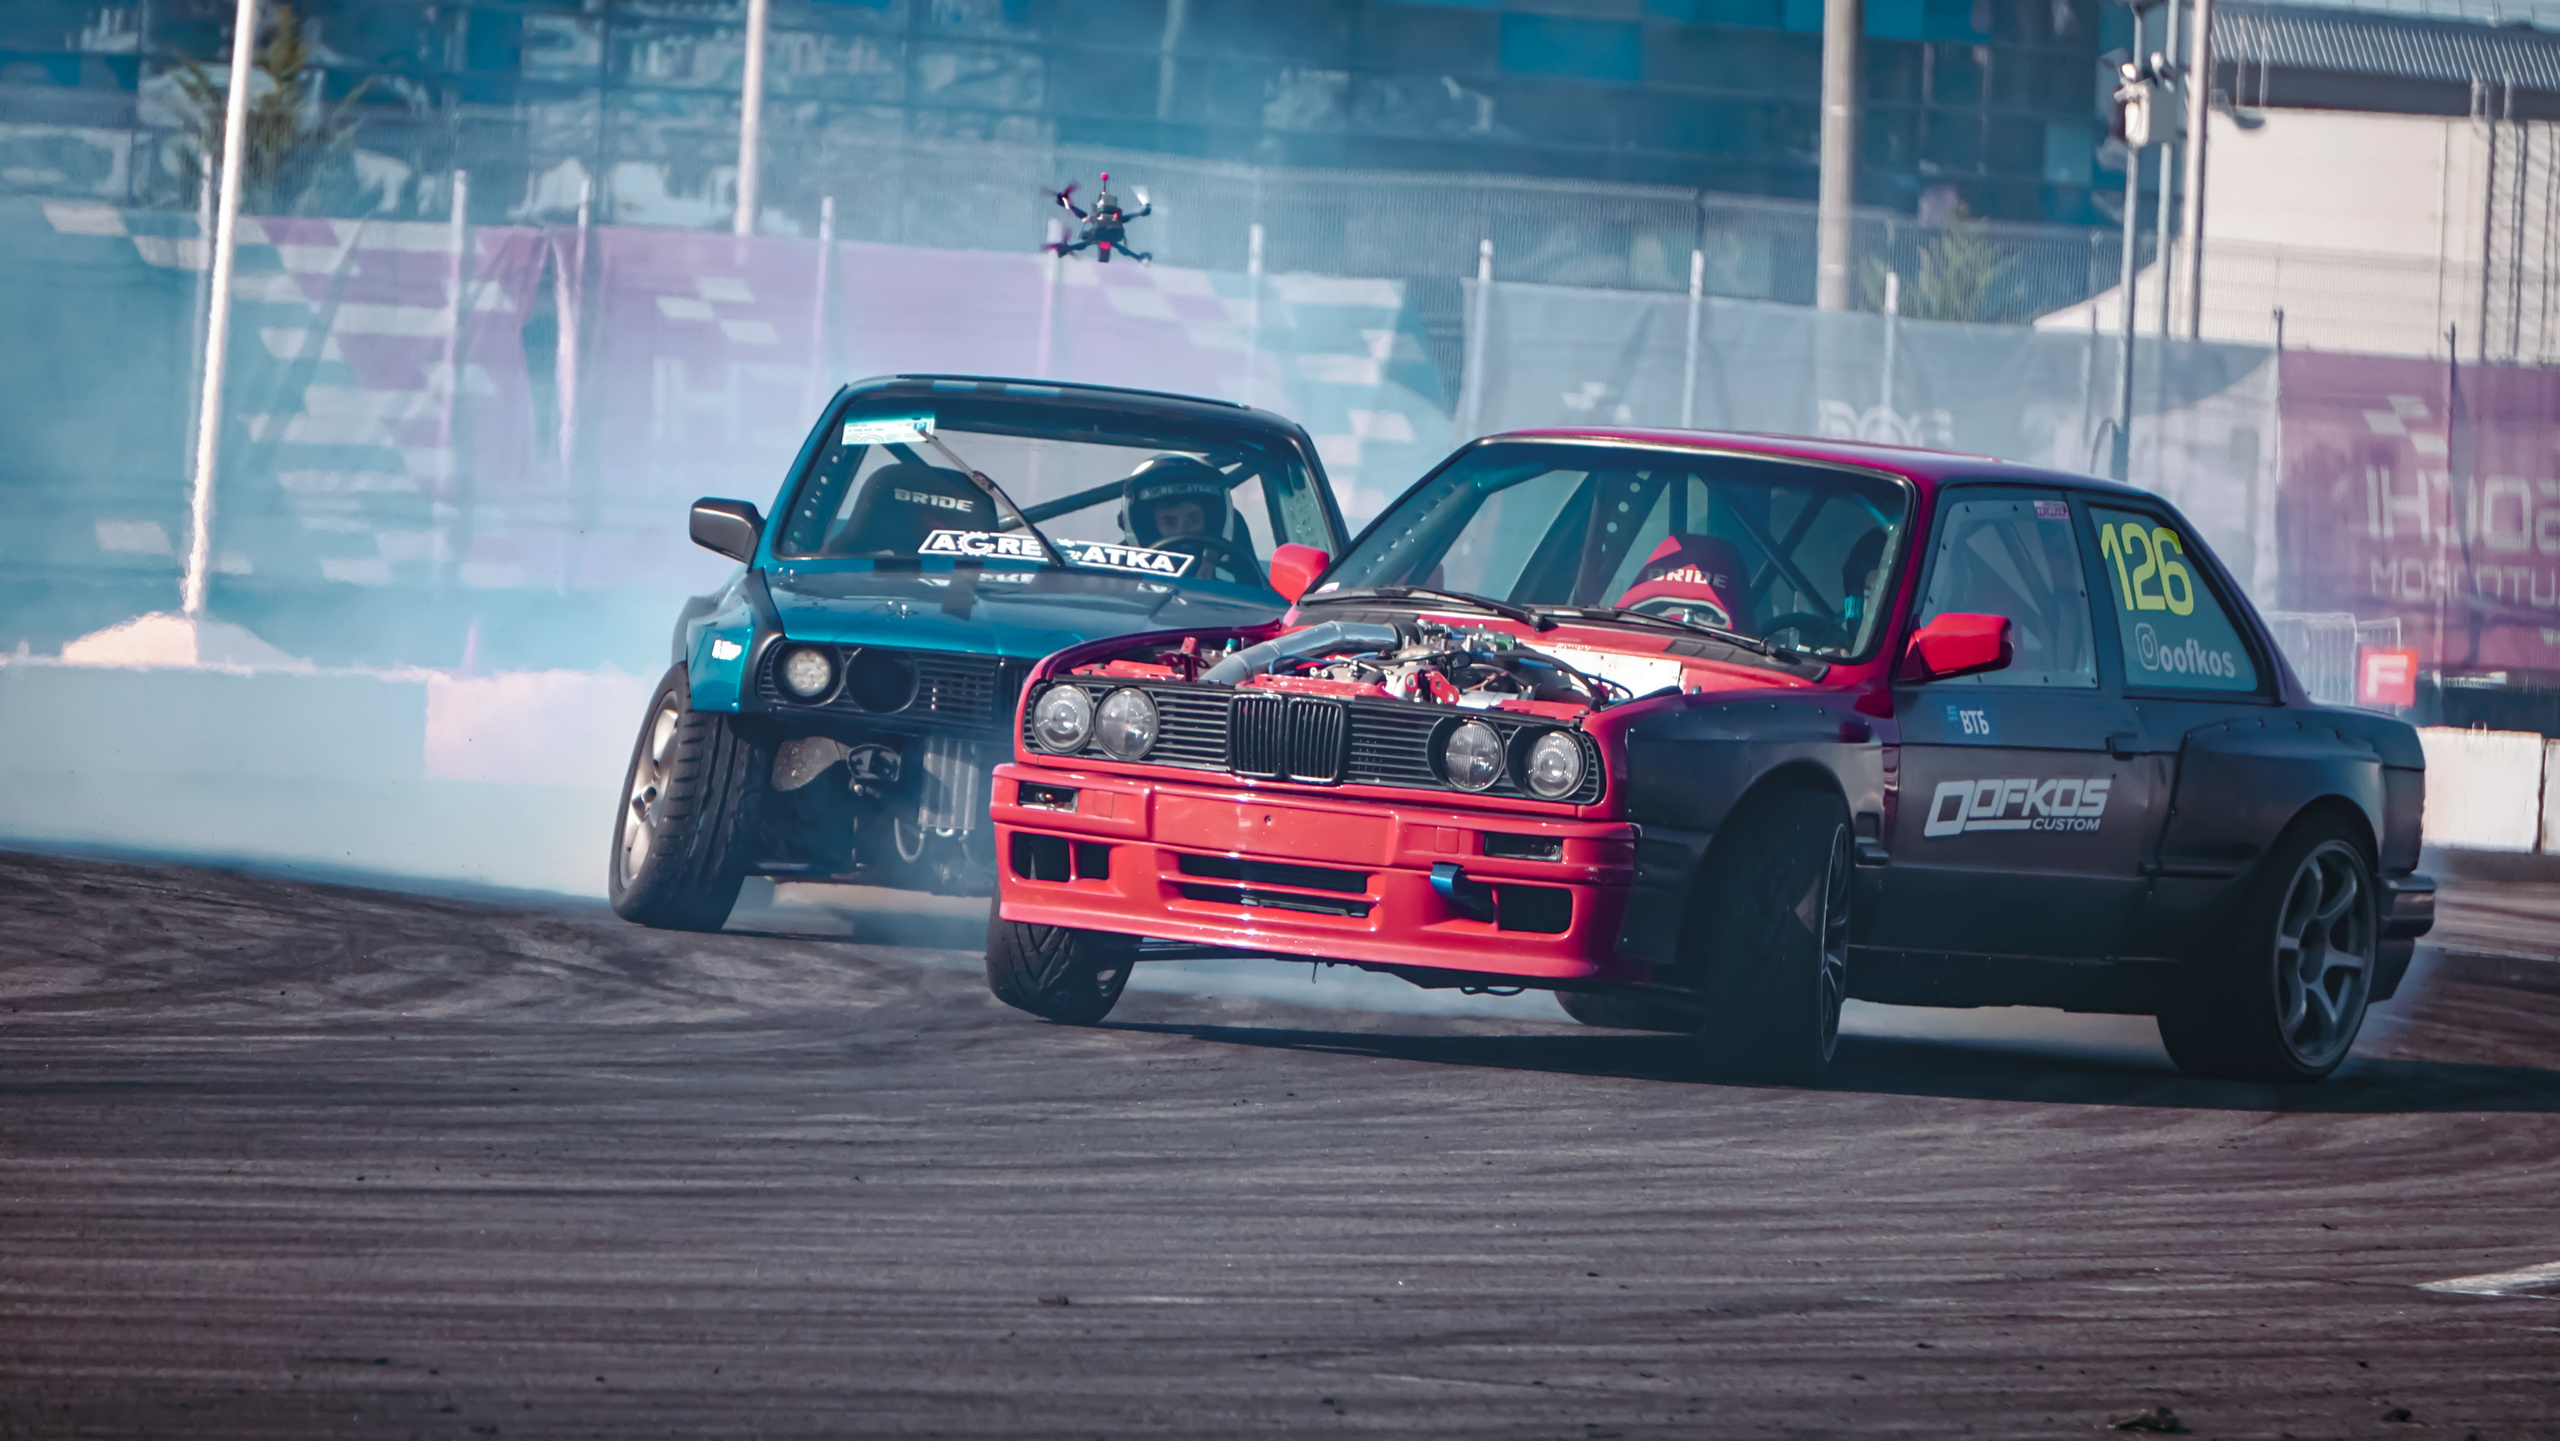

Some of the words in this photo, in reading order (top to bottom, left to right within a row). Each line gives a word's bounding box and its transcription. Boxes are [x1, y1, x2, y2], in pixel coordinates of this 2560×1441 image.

[895, 488, 973, 513] BRIDE
[1648, 568, 1728, 589] BRIDE
[2101, 523, 2194, 616] 126
[1960, 710, 1989, 734] ВТБ
[1924, 778, 2111, 837] OOFKOS
[2032, 818, 2101, 831] CUSTOM
